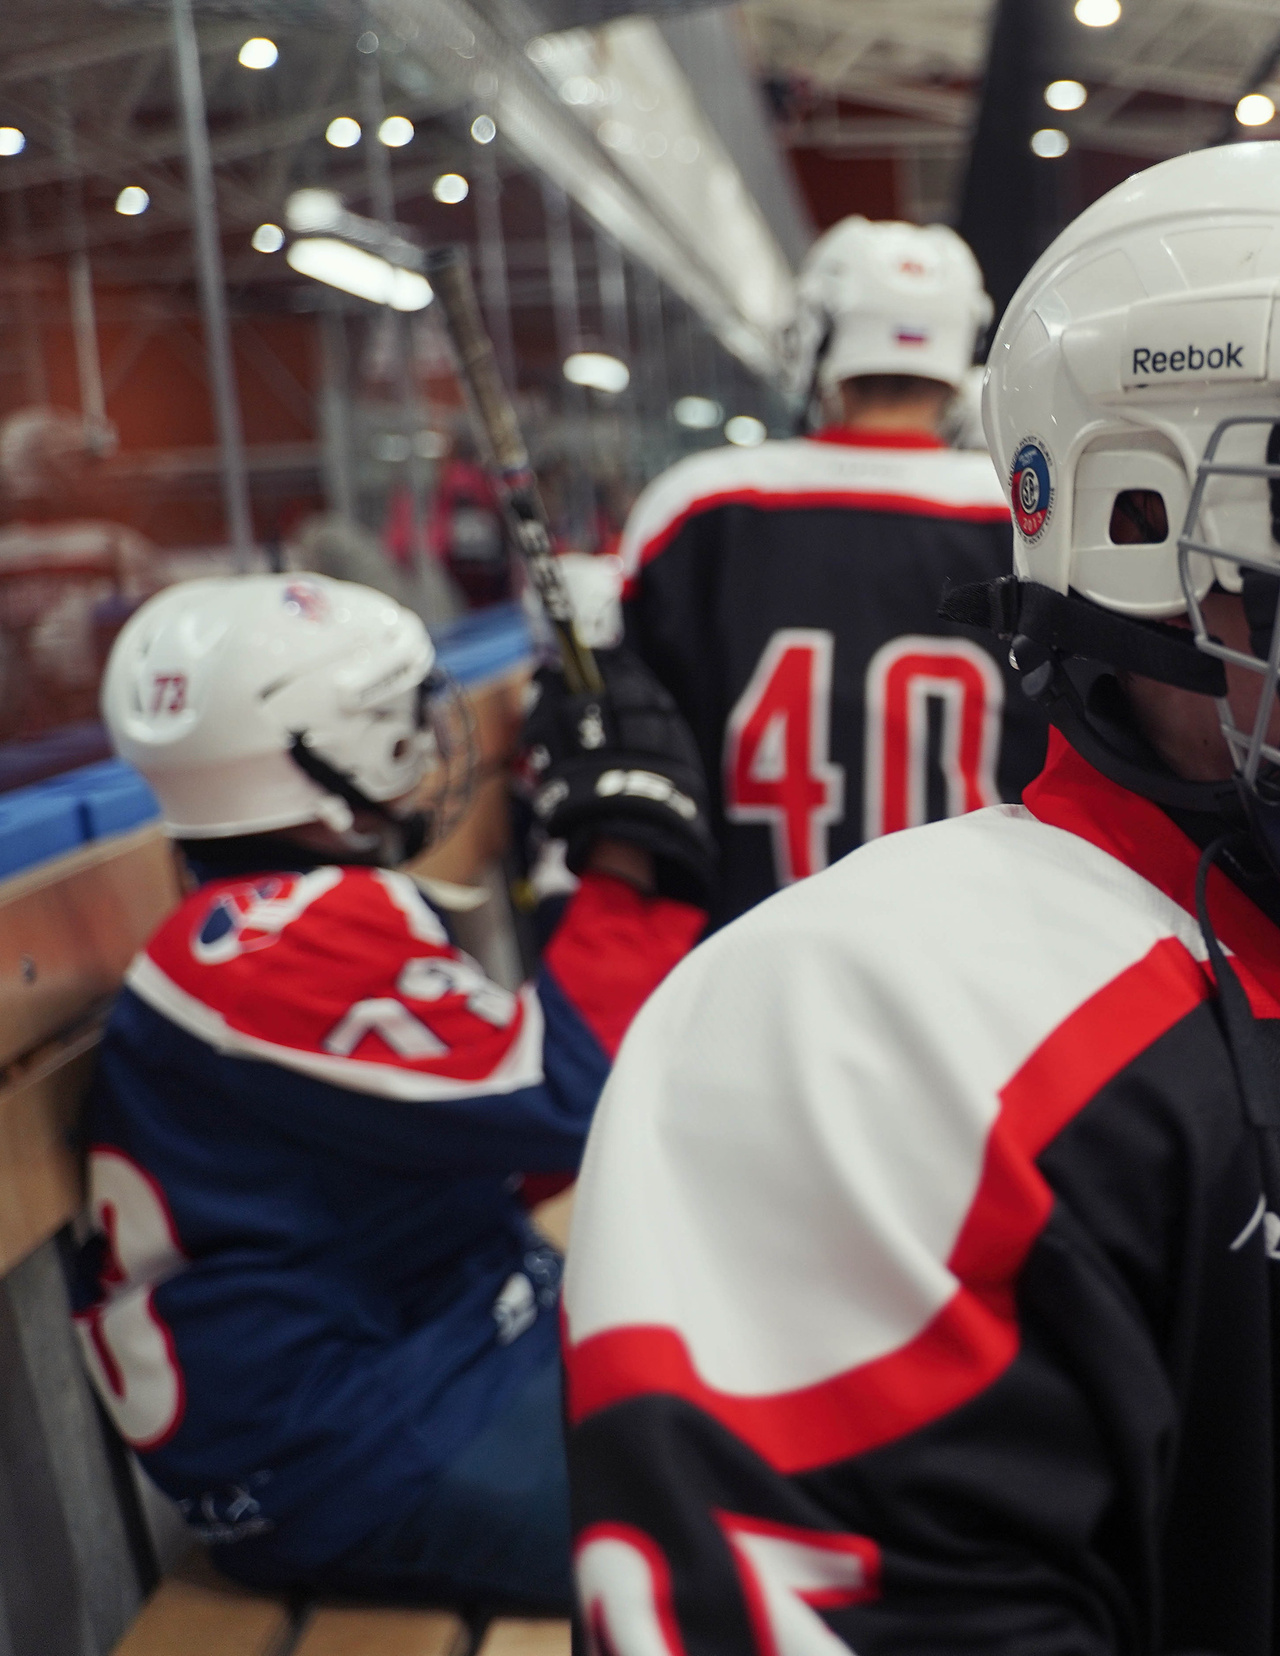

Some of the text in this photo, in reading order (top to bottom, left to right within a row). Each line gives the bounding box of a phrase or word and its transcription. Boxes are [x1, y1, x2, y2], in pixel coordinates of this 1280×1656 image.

[1132, 342, 1243, 375] Reebok
[150, 671, 187, 715] 73
[723, 627, 1004, 886] 40
